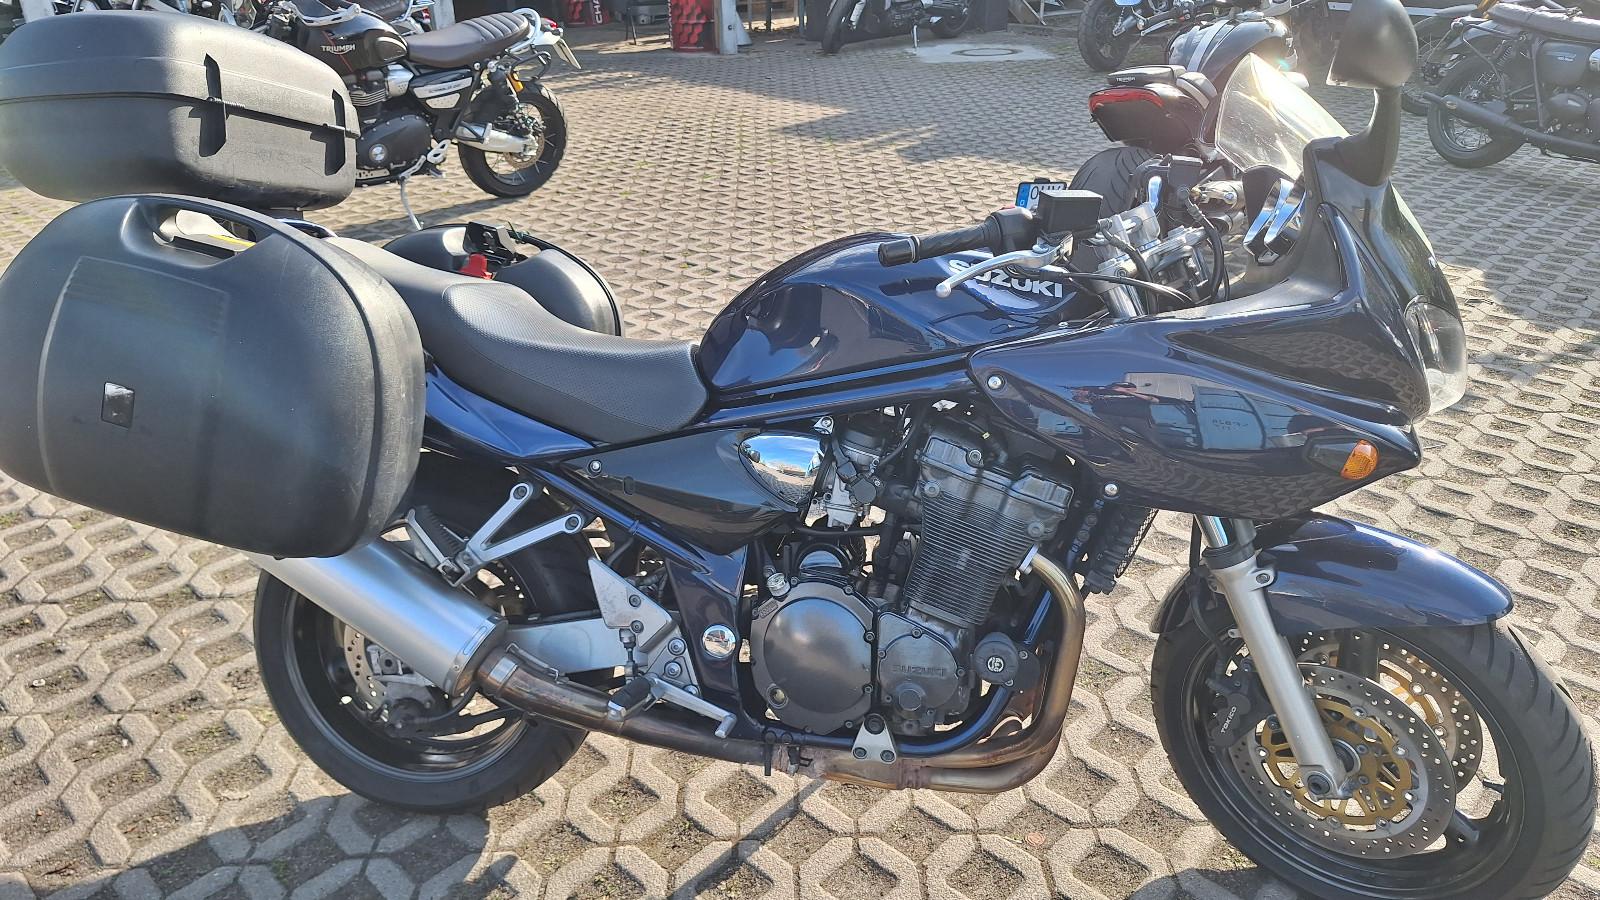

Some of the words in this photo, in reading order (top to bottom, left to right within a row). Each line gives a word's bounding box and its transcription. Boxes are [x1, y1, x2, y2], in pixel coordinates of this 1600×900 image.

[320, 44, 356, 54] TRIUMPH
[891, 664, 946, 677] SUZUKI
[1220, 706, 1237, 734] TOKICO
